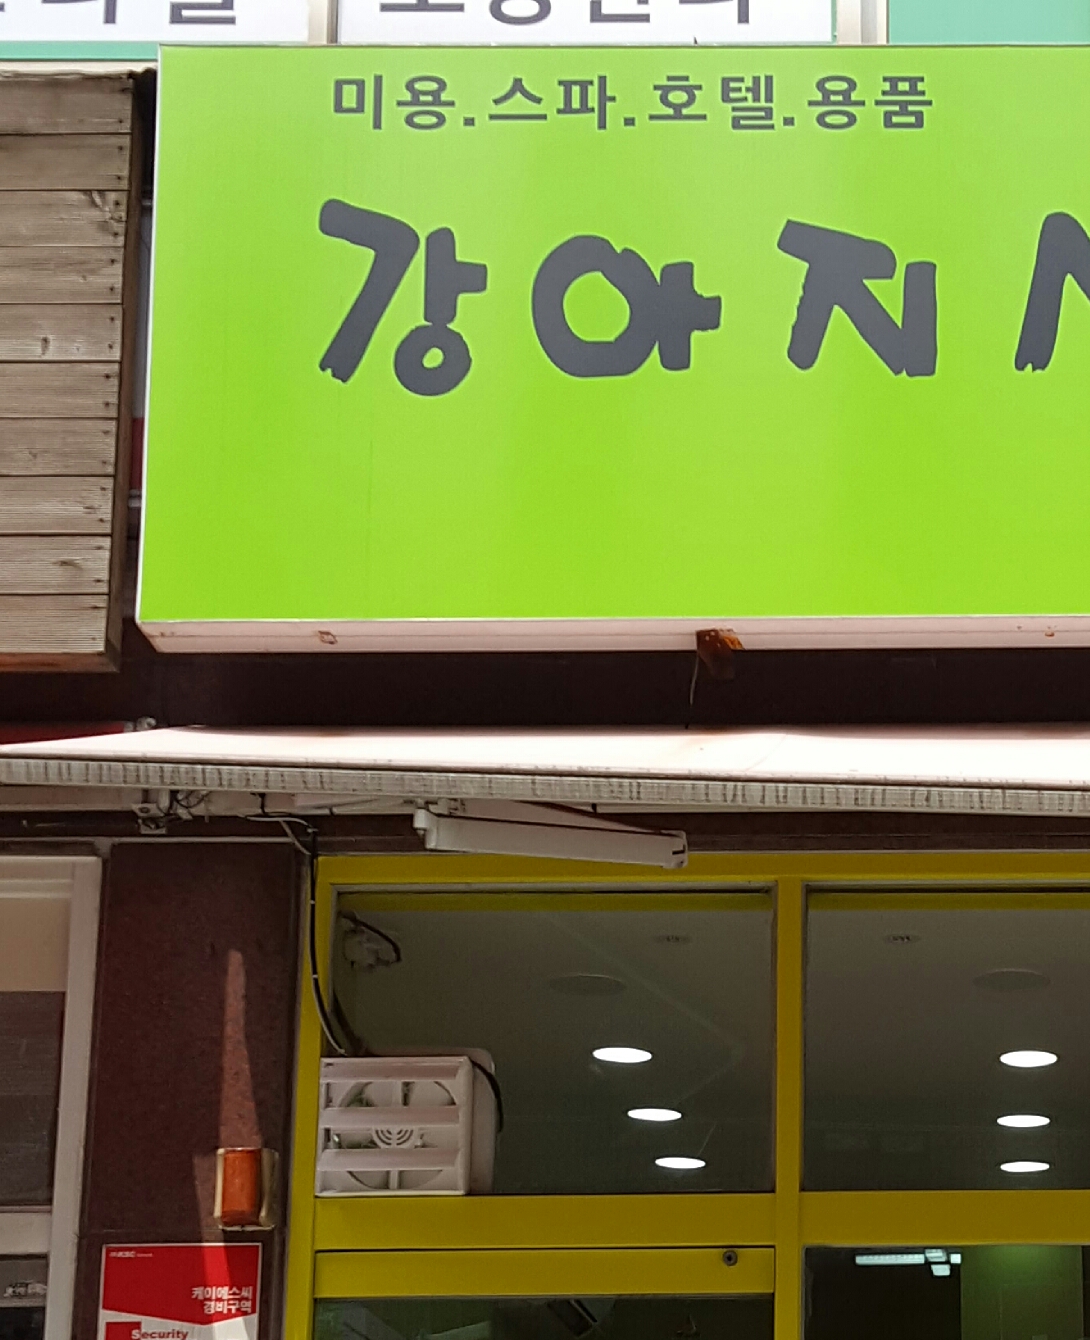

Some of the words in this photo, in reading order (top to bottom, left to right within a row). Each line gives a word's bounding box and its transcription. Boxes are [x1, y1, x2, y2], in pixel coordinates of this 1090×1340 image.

[333, 73, 930, 131] 미용.스파.호텔.용품
[203, 1301, 252, 1314] 경비구역
[131, 1329, 189, 1340] Security
